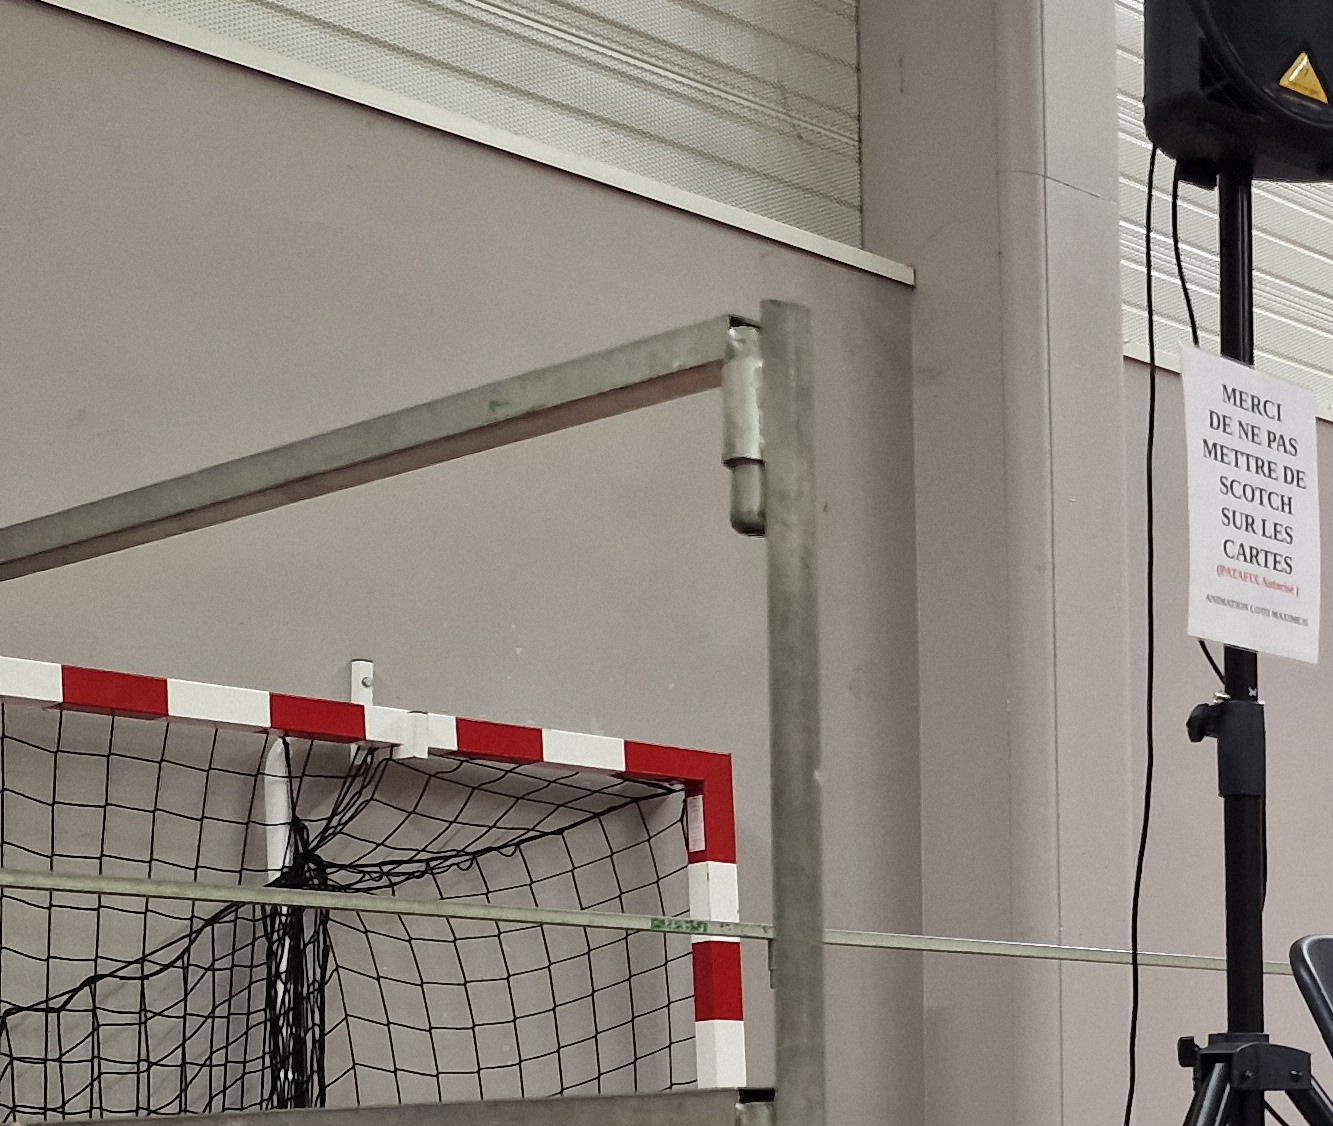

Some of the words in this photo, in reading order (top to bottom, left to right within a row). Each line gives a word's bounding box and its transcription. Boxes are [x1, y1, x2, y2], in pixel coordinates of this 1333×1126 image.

[1222, 383, 1283, 423] MERCI
[1208, 409, 1233, 436] DE
[1237, 419, 1263, 447] NE
[1266, 429, 1299, 457] PAS
[1202, 438, 1279, 481] METTRE
[1282, 465, 1307, 490] DE
[1219, 475, 1294, 516] SCOTCH
[1221, 507, 1258, 536] SUR
[1261, 518, 1294, 546] LES
[1223, 539, 1294, 575] CARTES
[1205, 593, 1250, 613] ANIMATION
